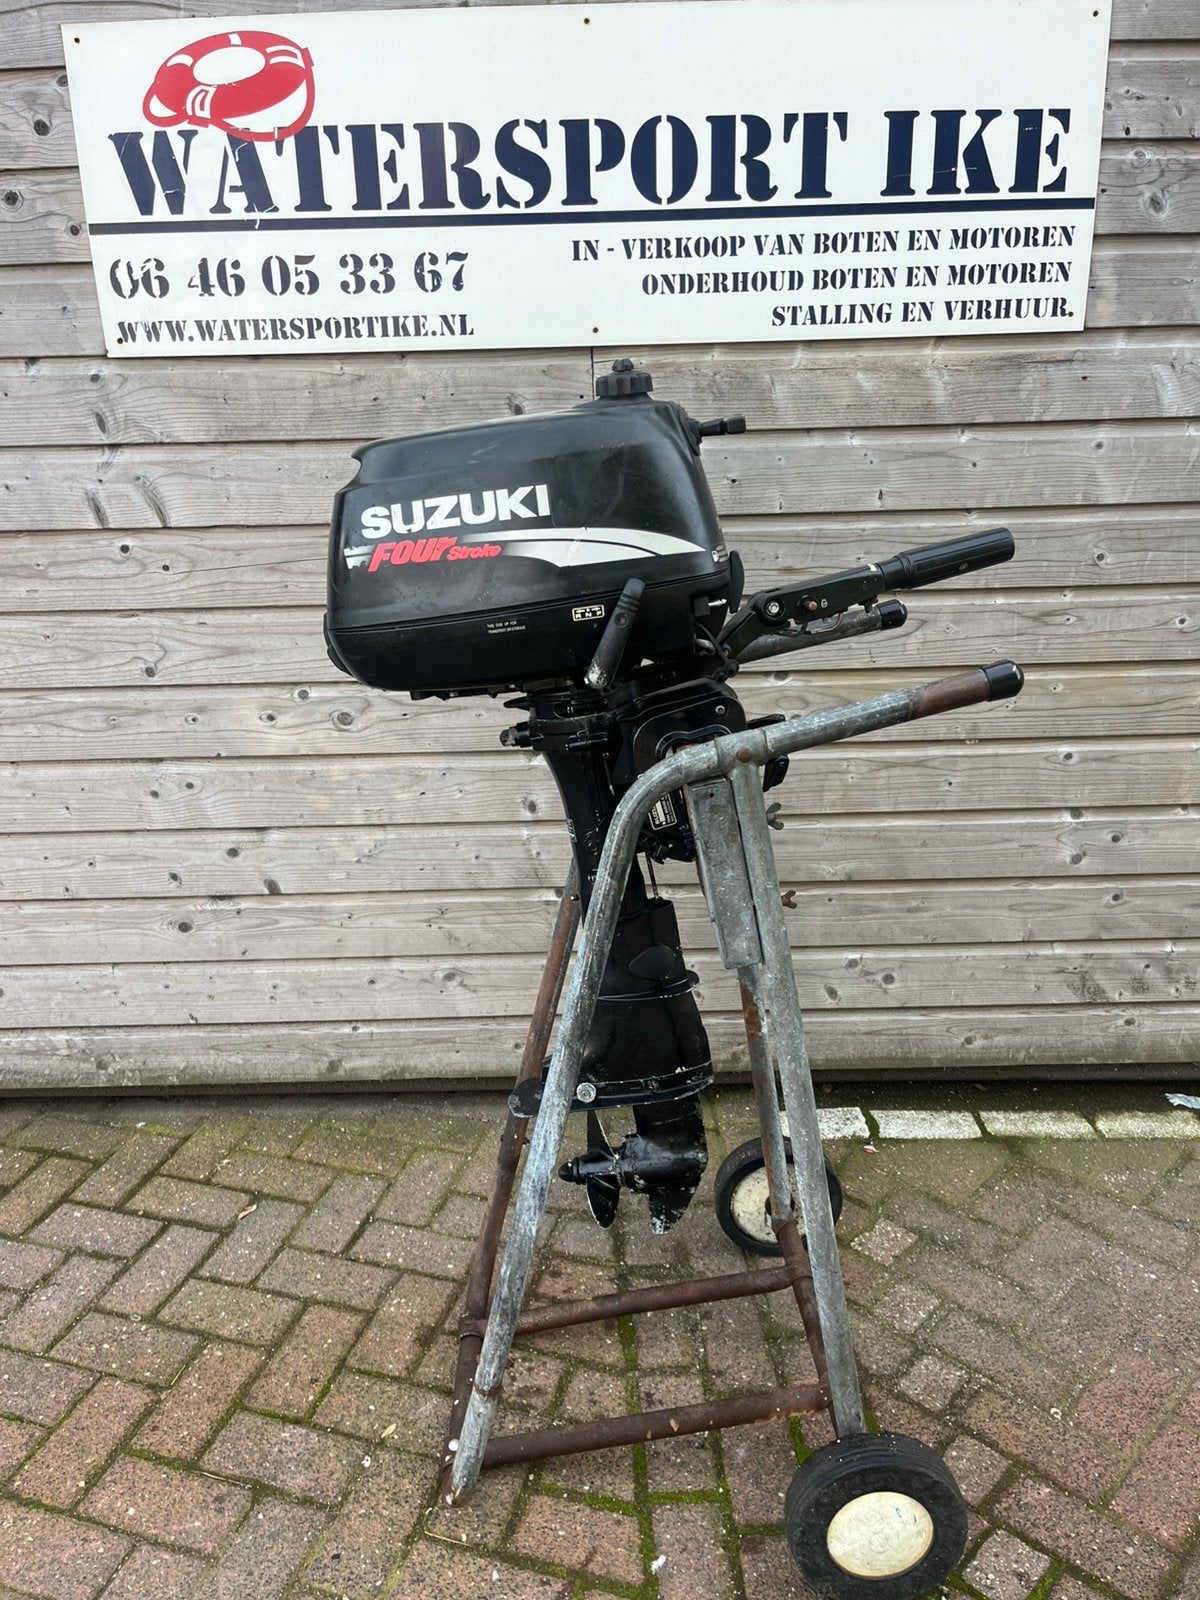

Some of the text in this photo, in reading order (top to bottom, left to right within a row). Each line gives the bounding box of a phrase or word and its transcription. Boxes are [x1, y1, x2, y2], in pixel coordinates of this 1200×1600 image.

[108, 108, 1071, 216] WATERSPORT IKE
[572, 239, 600, 261] IN
[622, 235, 746, 260] VERKOOP
[753, 233, 805, 256] VAN
[813, 231, 900, 255] BOTEN
[907, 229, 942, 251] EN
[949, 225, 1076, 250] MOTOREN
[109, 251, 469, 299] 06 46 05 33 67
[642, 261, 1073, 296] ONDERHOUD BOTEN EN MOTOREN
[117, 314, 474, 343] WWW.WATERSPORTIKE.NL
[771, 302, 892, 327] STALLING
[901, 301, 935, 323] EN
[361, 484, 551, 539] SUZUKI
[446, 544, 503, 562] Stroke
